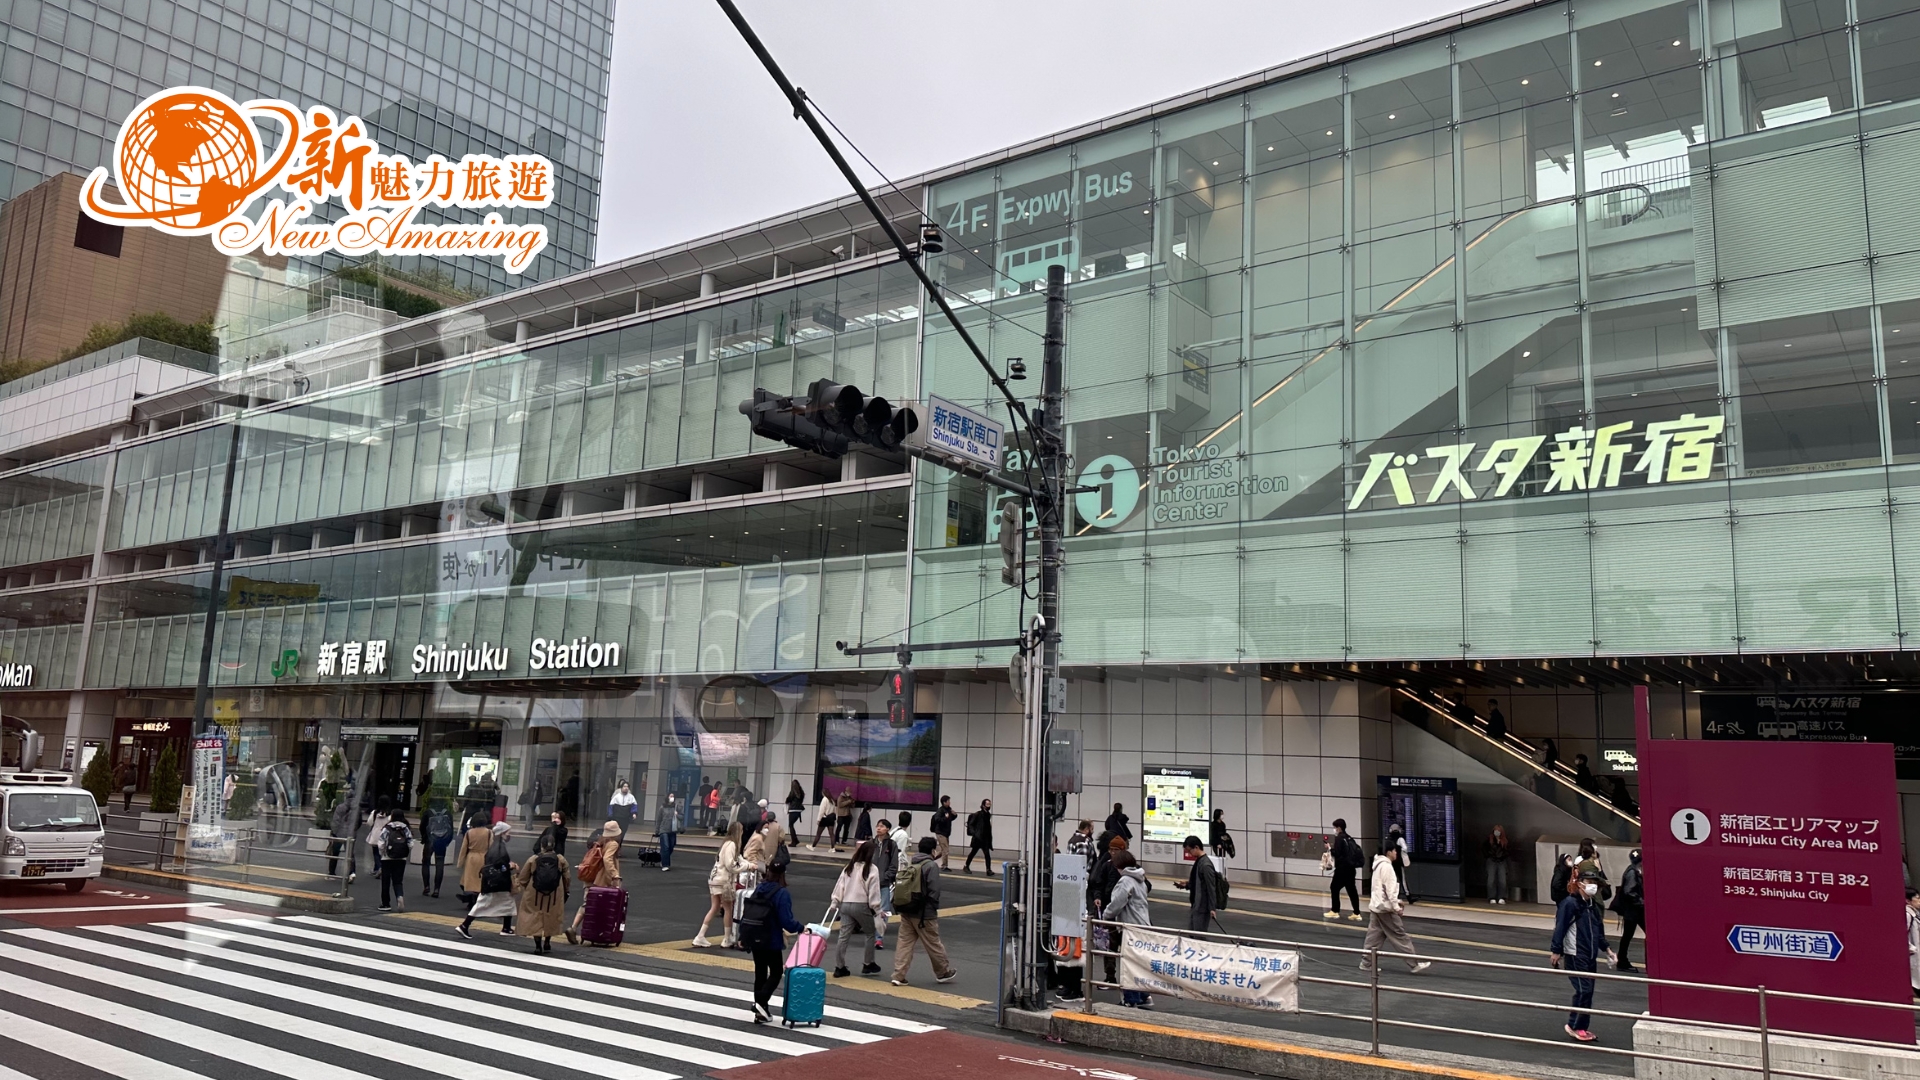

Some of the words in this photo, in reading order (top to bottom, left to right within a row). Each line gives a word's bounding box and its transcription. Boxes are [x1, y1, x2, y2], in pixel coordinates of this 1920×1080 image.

[946, 200, 988, 235] 4F
[1085, 171, 1133, 203] Bus
[933, 405, 998, 449] 新宿駅南口
[933, 427, 965, 450] Shinjuku
[967, 441, 980, 455] Sta.
[989, 450, 996, 463] S.
[1153, 443, 1220, 465] Tokyo
[1153, 459, 1232, 484] Tourist
[1347, 413, 1725, 510] バスタ新宿
[1153, 475, 1288, 504] Information
[1153, 502, 1227, 523] Center
[271, 649, 299, 678] JR
[317, 639, 388, 676] 新宿駅
[411, 641, 509, 680] Shinjuku
[529, 636, 620, 670] Station
[1792, 697, 1862, 709] バスタ新宿
[1706, 720, 1724, 734] 4F
[1797, 720, 1846, 731] 高速バス
[1799, 733, 1847, 742] Expressway
[1850, 733, 1865, 741] Bus
[1720, 813, 1880, 835] 新宿区エリアマップ
[1721, 833, 1777, 847] Shinjuku
[1781, 835, 1807, 848] City
[1811, 837, 1843, 849] Area
[1848, 839, 1879, 852] Map
[1724, 885, 1758, 897] 3-38-2,
[1760, 888, 1805, 900] Shinjuku
[1808, 890, 1829, 902] City
[1741, 930, 1830, 955] 甲州街道
[1150, 959, 1261, 990] 乗降は出来ません
